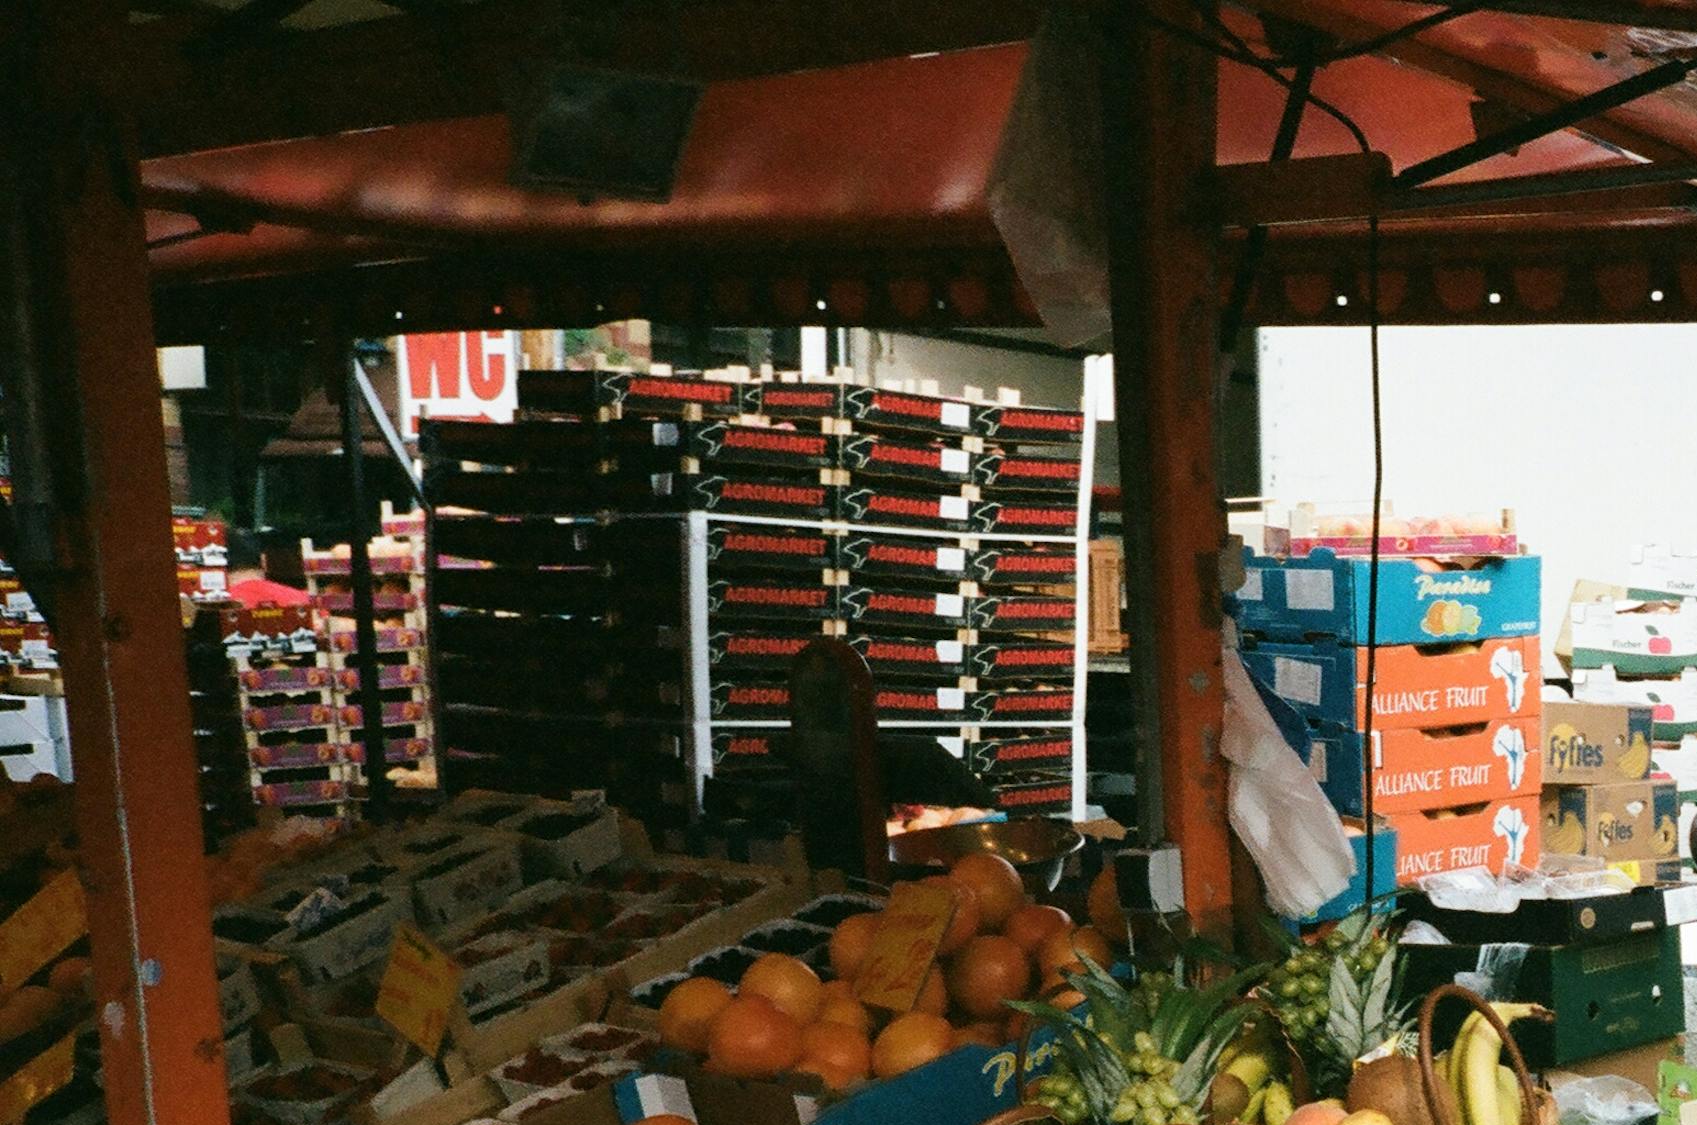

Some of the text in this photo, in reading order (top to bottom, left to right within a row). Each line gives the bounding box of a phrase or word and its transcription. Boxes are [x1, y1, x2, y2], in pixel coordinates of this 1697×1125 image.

[404, 331, 506, 402] WC
[628, 379, 734, 404] AGROMARKET
[872, 395, 942, 420] AGROMAR
[724, 430, 828, 456] AGROMARKET
[870, 443, 942, 469] AGROMAR
[722, 482, 827, 506] AGROMARKET
[867, 495, 940, 519] AGROMAR
[996, 508, 1078, 527] AGROMARKE
[723, 535, 828, 557] AGROMARKET
[868, 546, 938, 567] AGROMAR
[725, 587, 828, 608] AGROMARKET
[867, 595, 937, 615] AGROMAR
[866, 644, 939, 663] AGROMAR
[1446, 685, 1490, 708] FRUIT
[996, 741, 1073, 761] AGROMARKE
[1375, 764, 1492, 797] ALLIANCE FRUIT
[998, 786, 1072, 806] AGROMARKE
[1396, 845, 1492, 877] IANCE FRUIT
